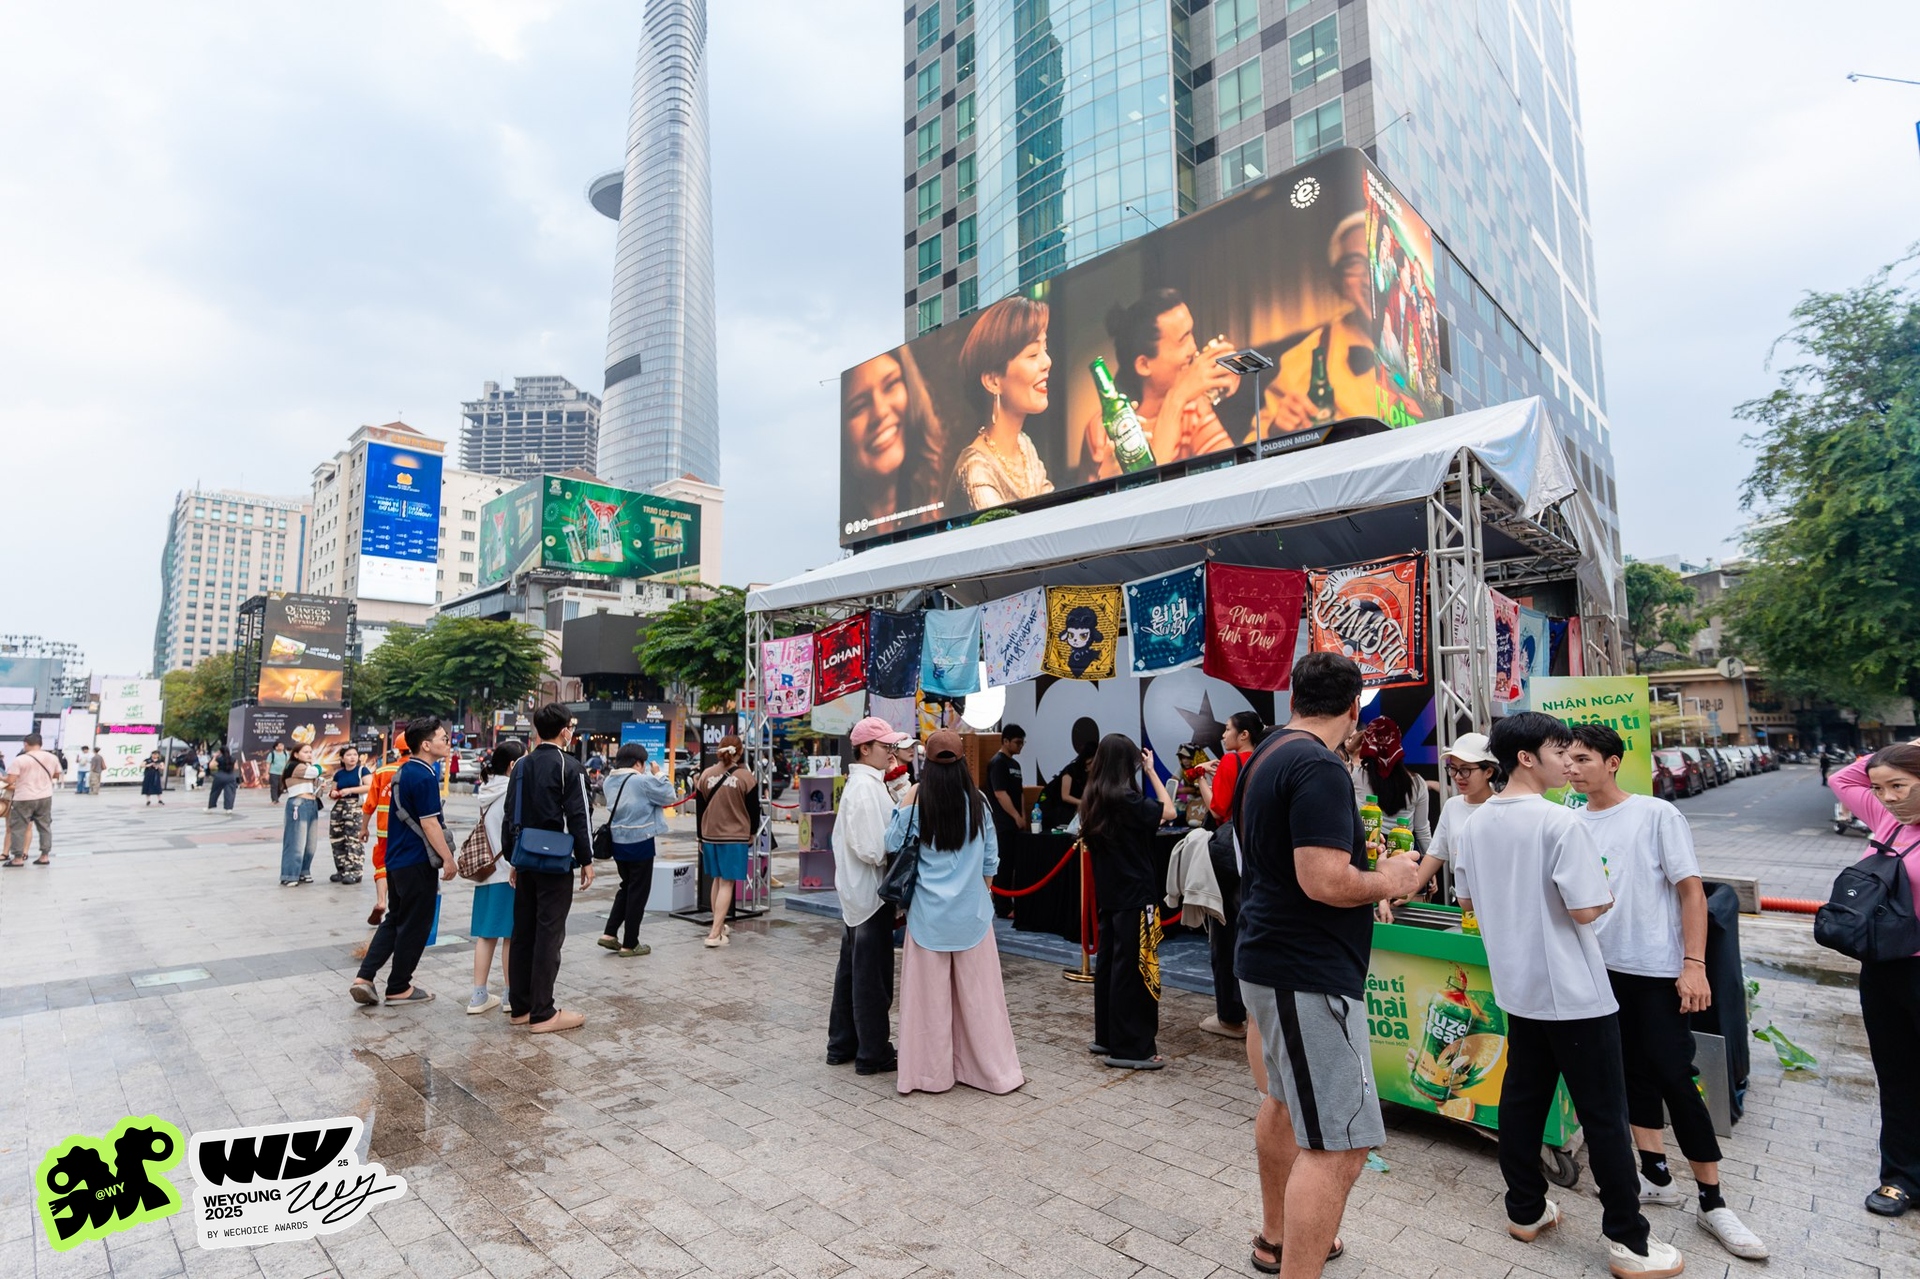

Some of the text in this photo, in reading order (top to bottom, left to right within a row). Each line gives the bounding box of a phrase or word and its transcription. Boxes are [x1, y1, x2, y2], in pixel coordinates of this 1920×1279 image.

[1261, 432, 1320, 453] OLDSUN MEDIA
[203, 490, 300, 510] HARBOUR VIEW TOWER
[1218, 624, 1241, 644] Anh
[1248, 630, 1275, 649] Duy
[1314, 584, 1409, 675] RHYMASTIC
[823, 645, 861, 670] LOHAN
[876, 630, 907, 670] LYHAN
[1542, 693, 1634, 711] NHẬN NGAY
[703, 723, 726, 744] idol
[116, 744, 143, 755] THE
[1426, 1019, 1455, 1044] tea
[1428, 1003, 1467, 1037] fuze
